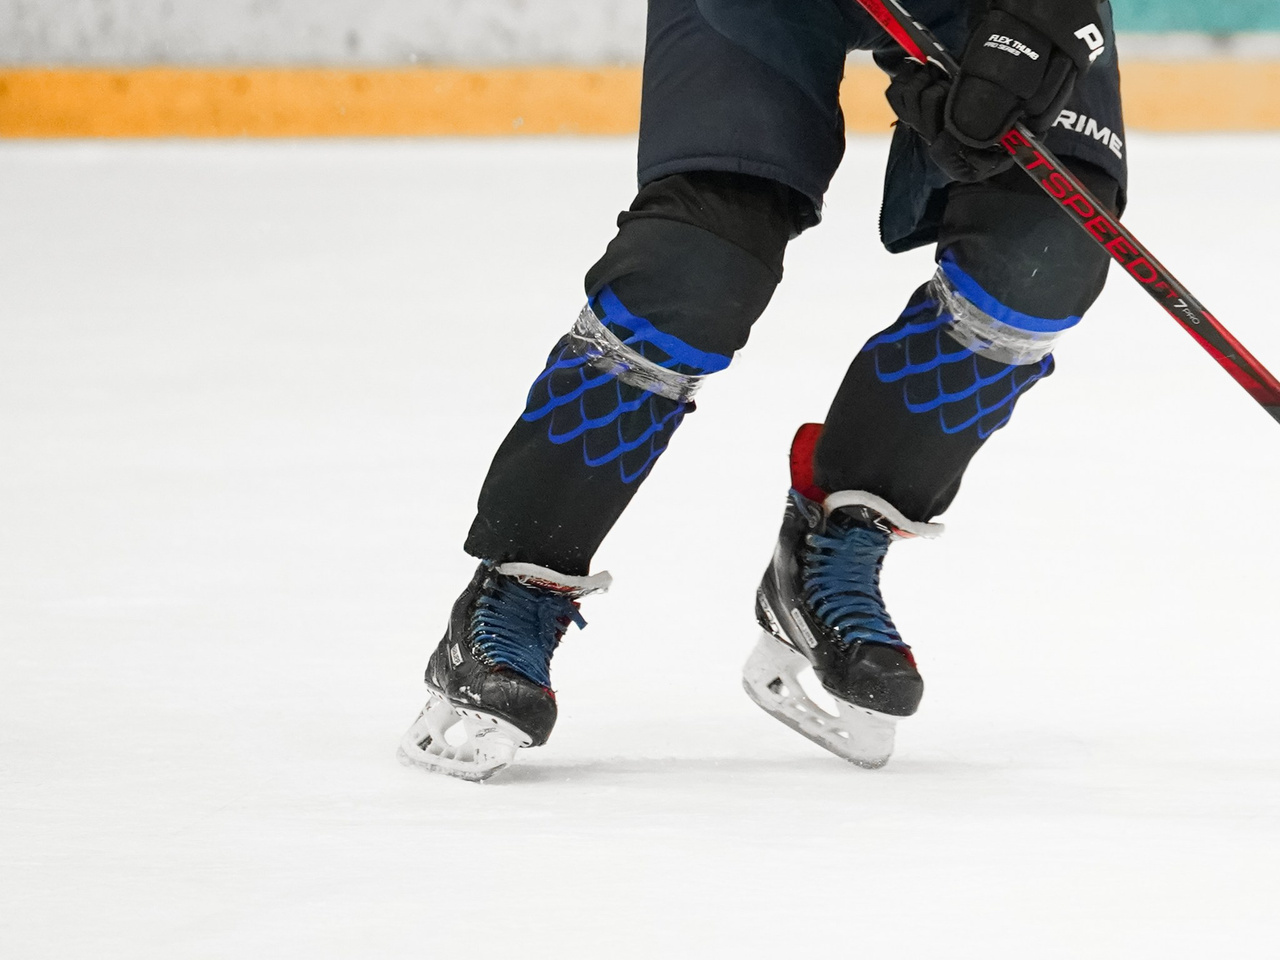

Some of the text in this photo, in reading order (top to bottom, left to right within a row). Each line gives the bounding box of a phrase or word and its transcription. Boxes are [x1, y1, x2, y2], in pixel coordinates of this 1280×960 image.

[988, 34, 1040, 60] FLEX THUMB
[1051, 109, 1123, 160] RIME
[1000, 128, 1158, 283] ETSPEED
